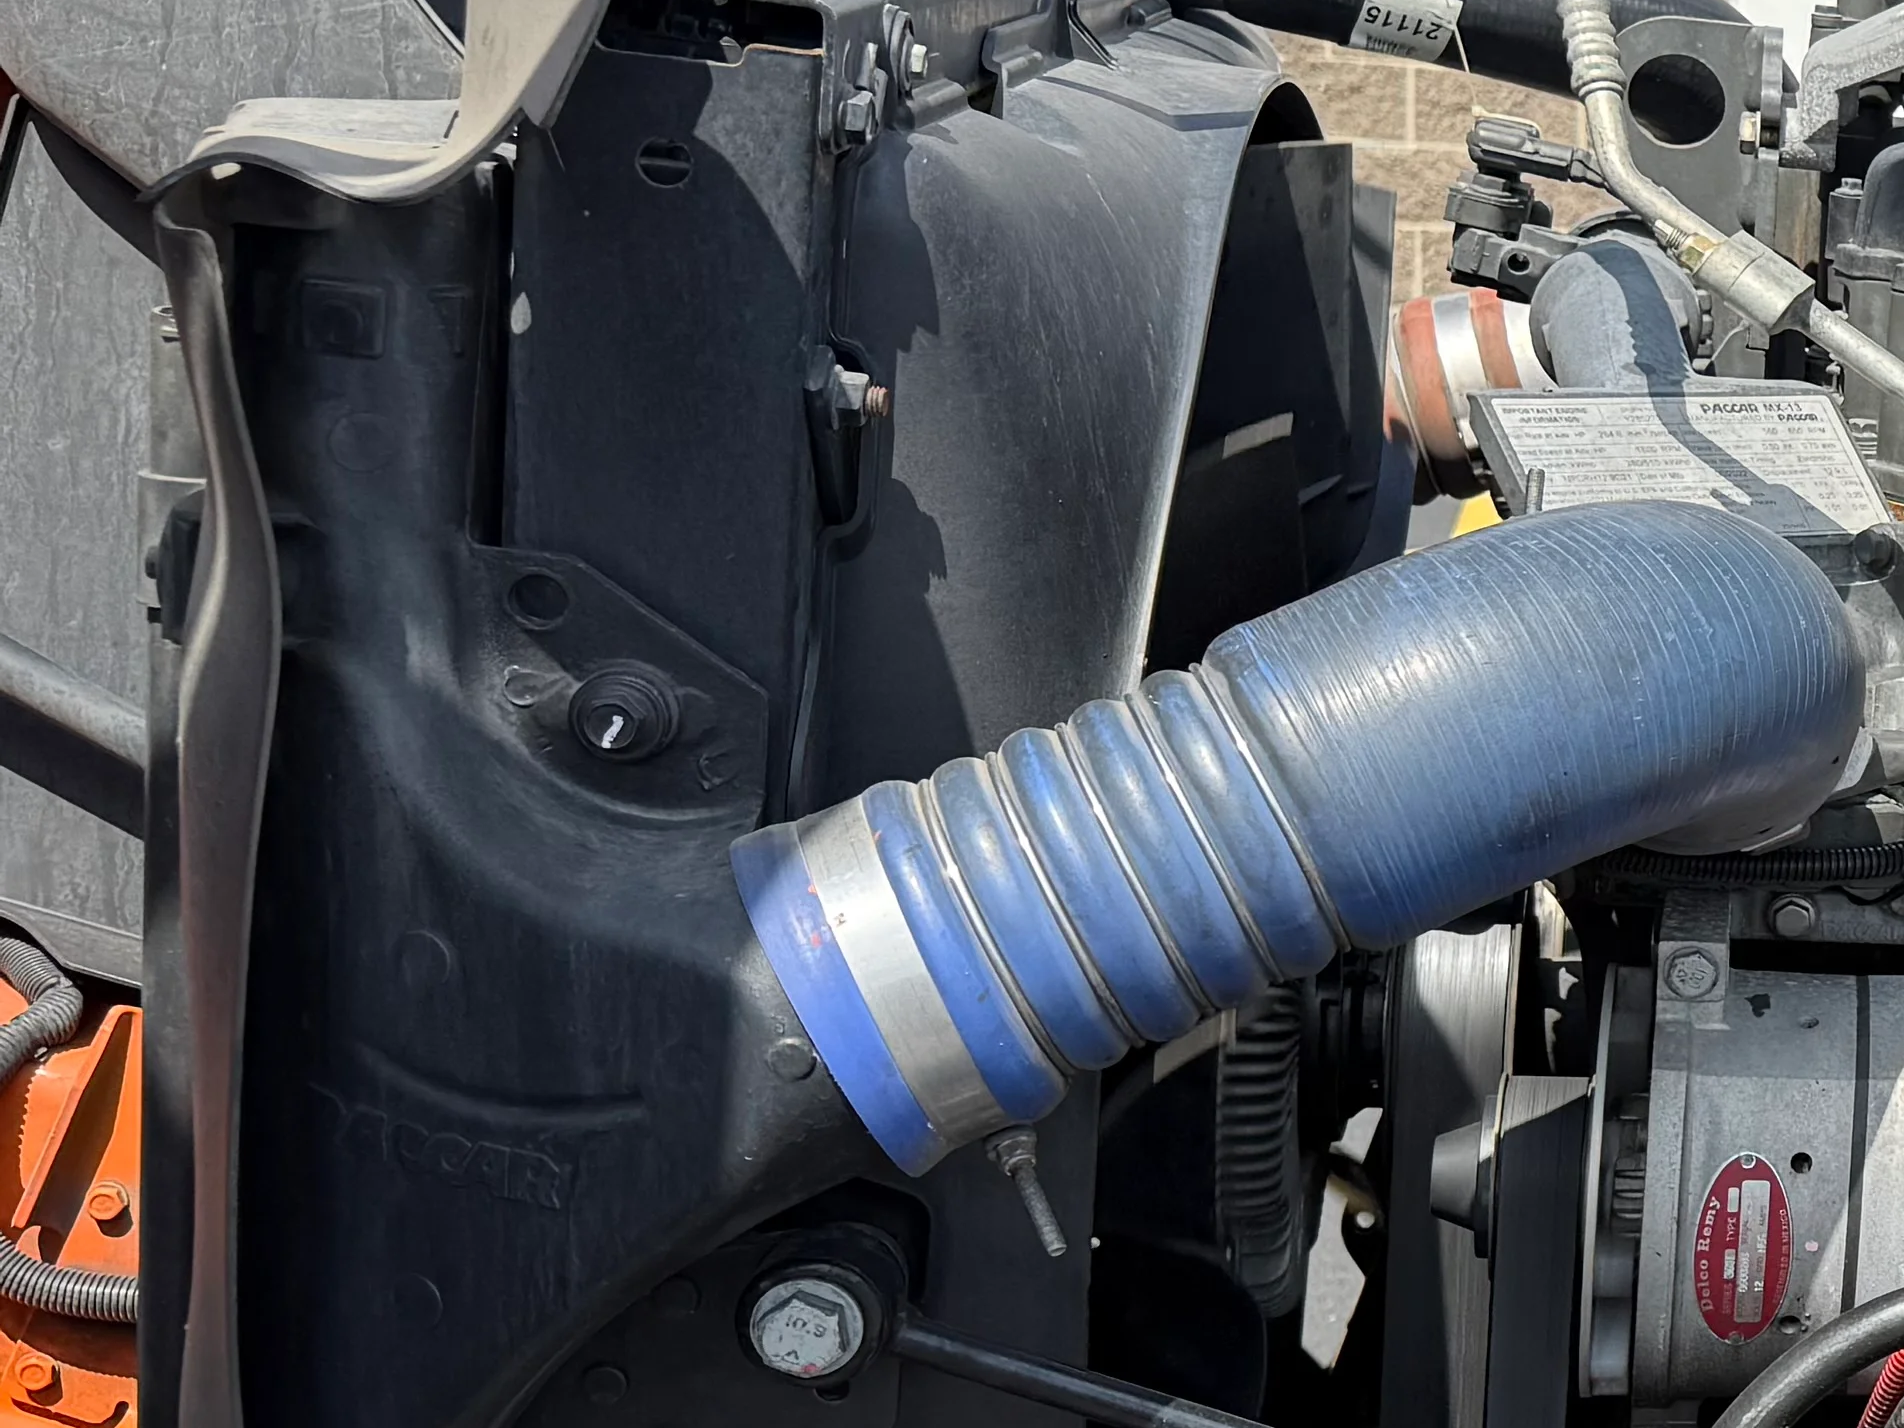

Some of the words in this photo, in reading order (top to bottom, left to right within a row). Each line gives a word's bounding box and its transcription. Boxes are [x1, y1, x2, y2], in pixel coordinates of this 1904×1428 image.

[1365, 6, 1439, 40] 21115
[1701, 403, 1759, 415] PACCAR
[1763, 402, 1803, 413] MX-13
[1778, 413, 1820, 422] PACCAR
[1697, 1196, 1721, 1252] Remy
[1697, 1259, 1714, 1312] Delco
